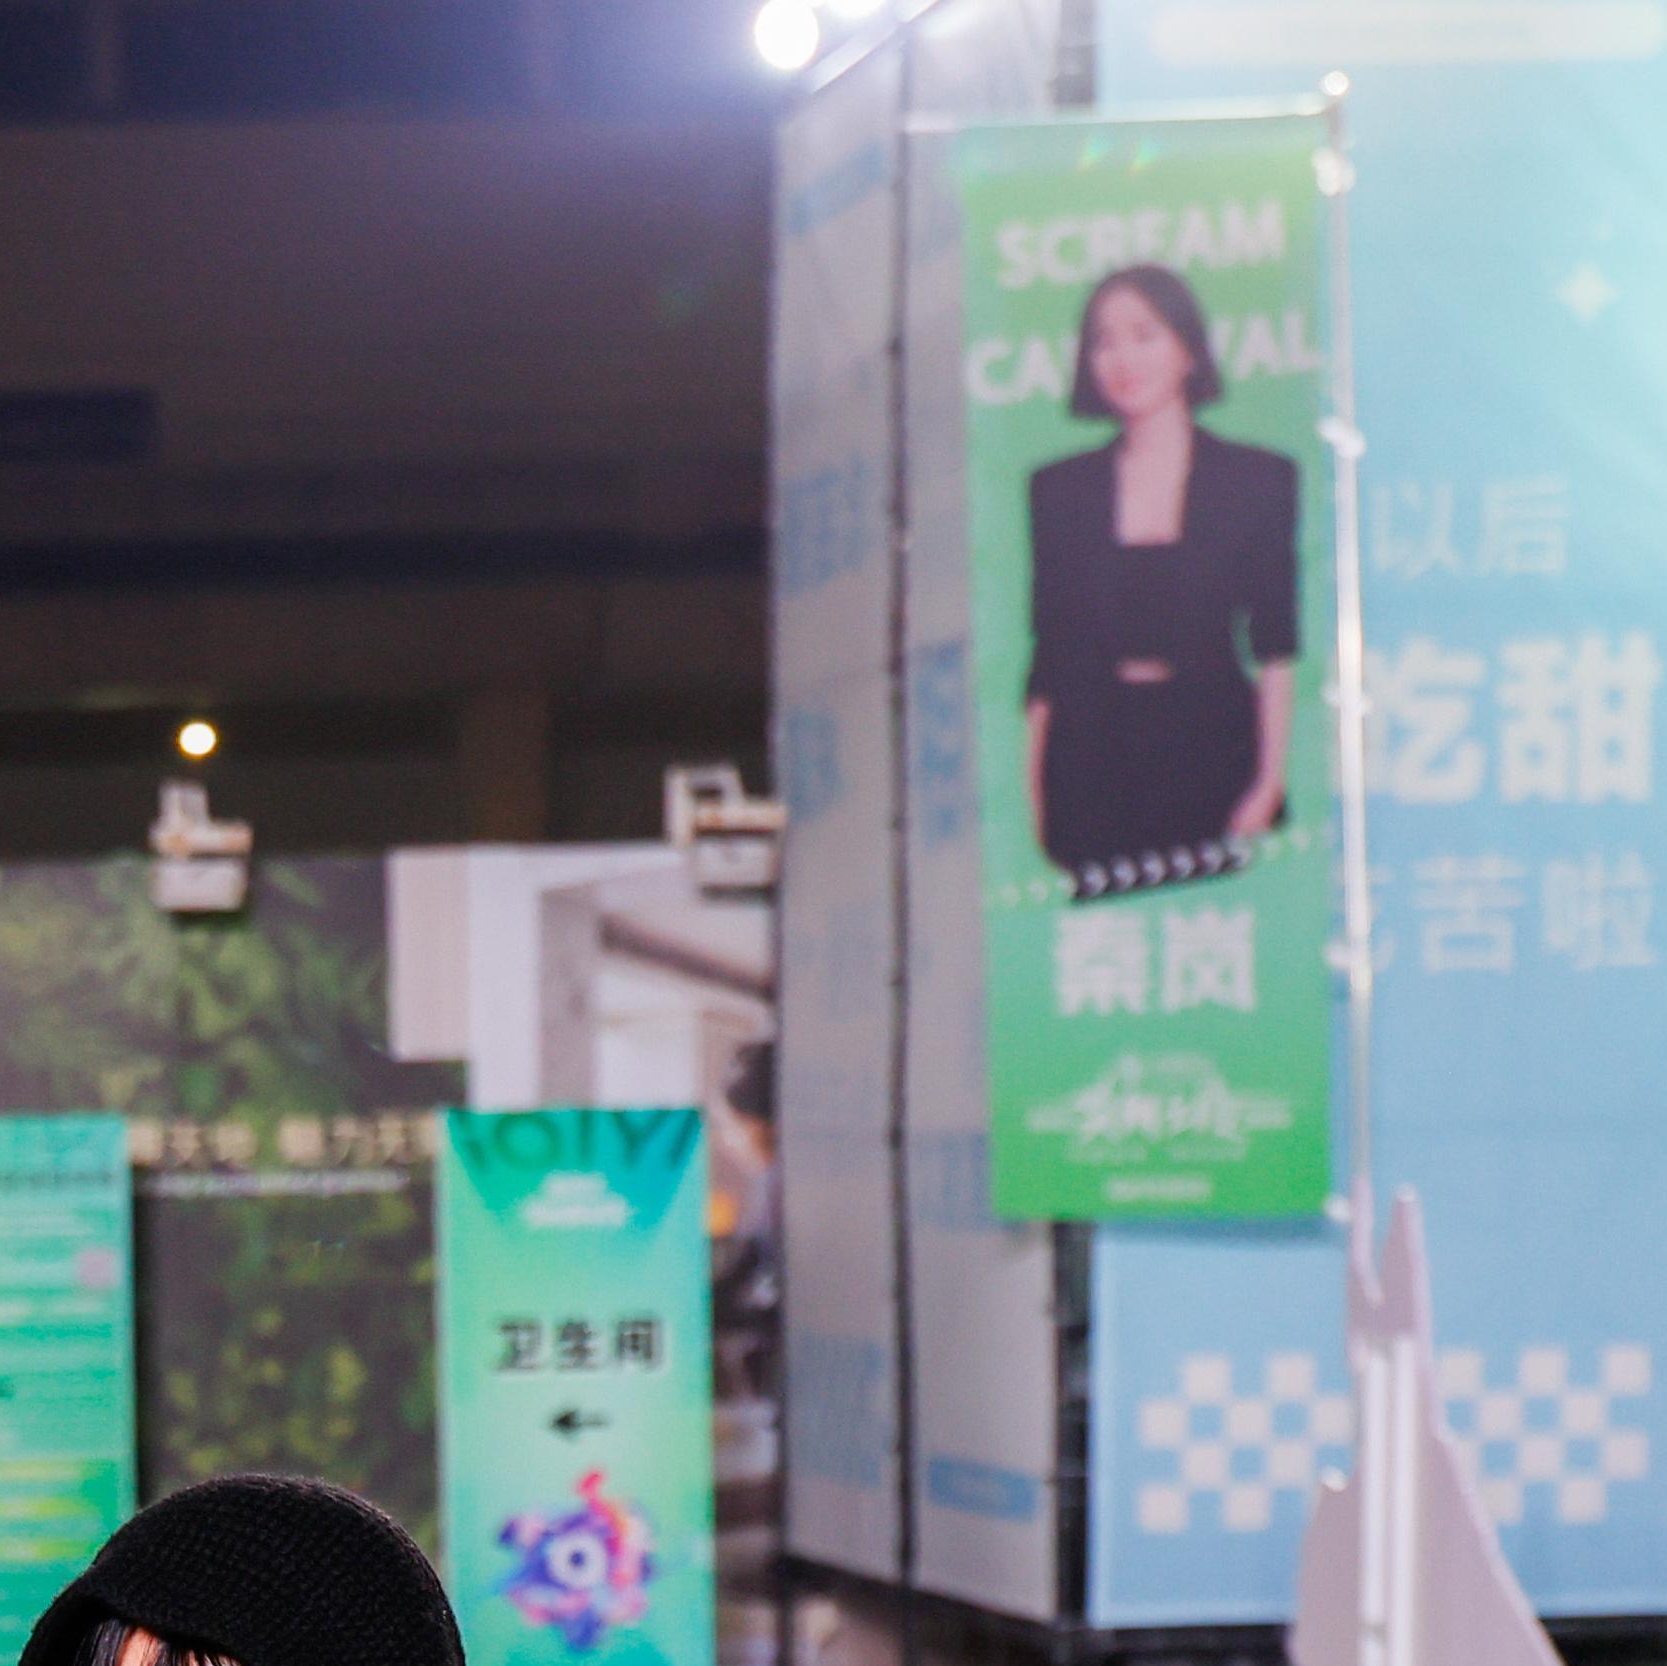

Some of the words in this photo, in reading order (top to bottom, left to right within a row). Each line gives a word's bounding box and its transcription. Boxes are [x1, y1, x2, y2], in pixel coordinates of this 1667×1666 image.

[996, 200, 1285, 289] SCREAM
[968, 308, 1325, 404] CAVAL
[1373, 478, 1569, 580] 以后
[1054, 909, 1257, 1016] 秦岚
[496, 1319, 663, 1371] 卫生间
